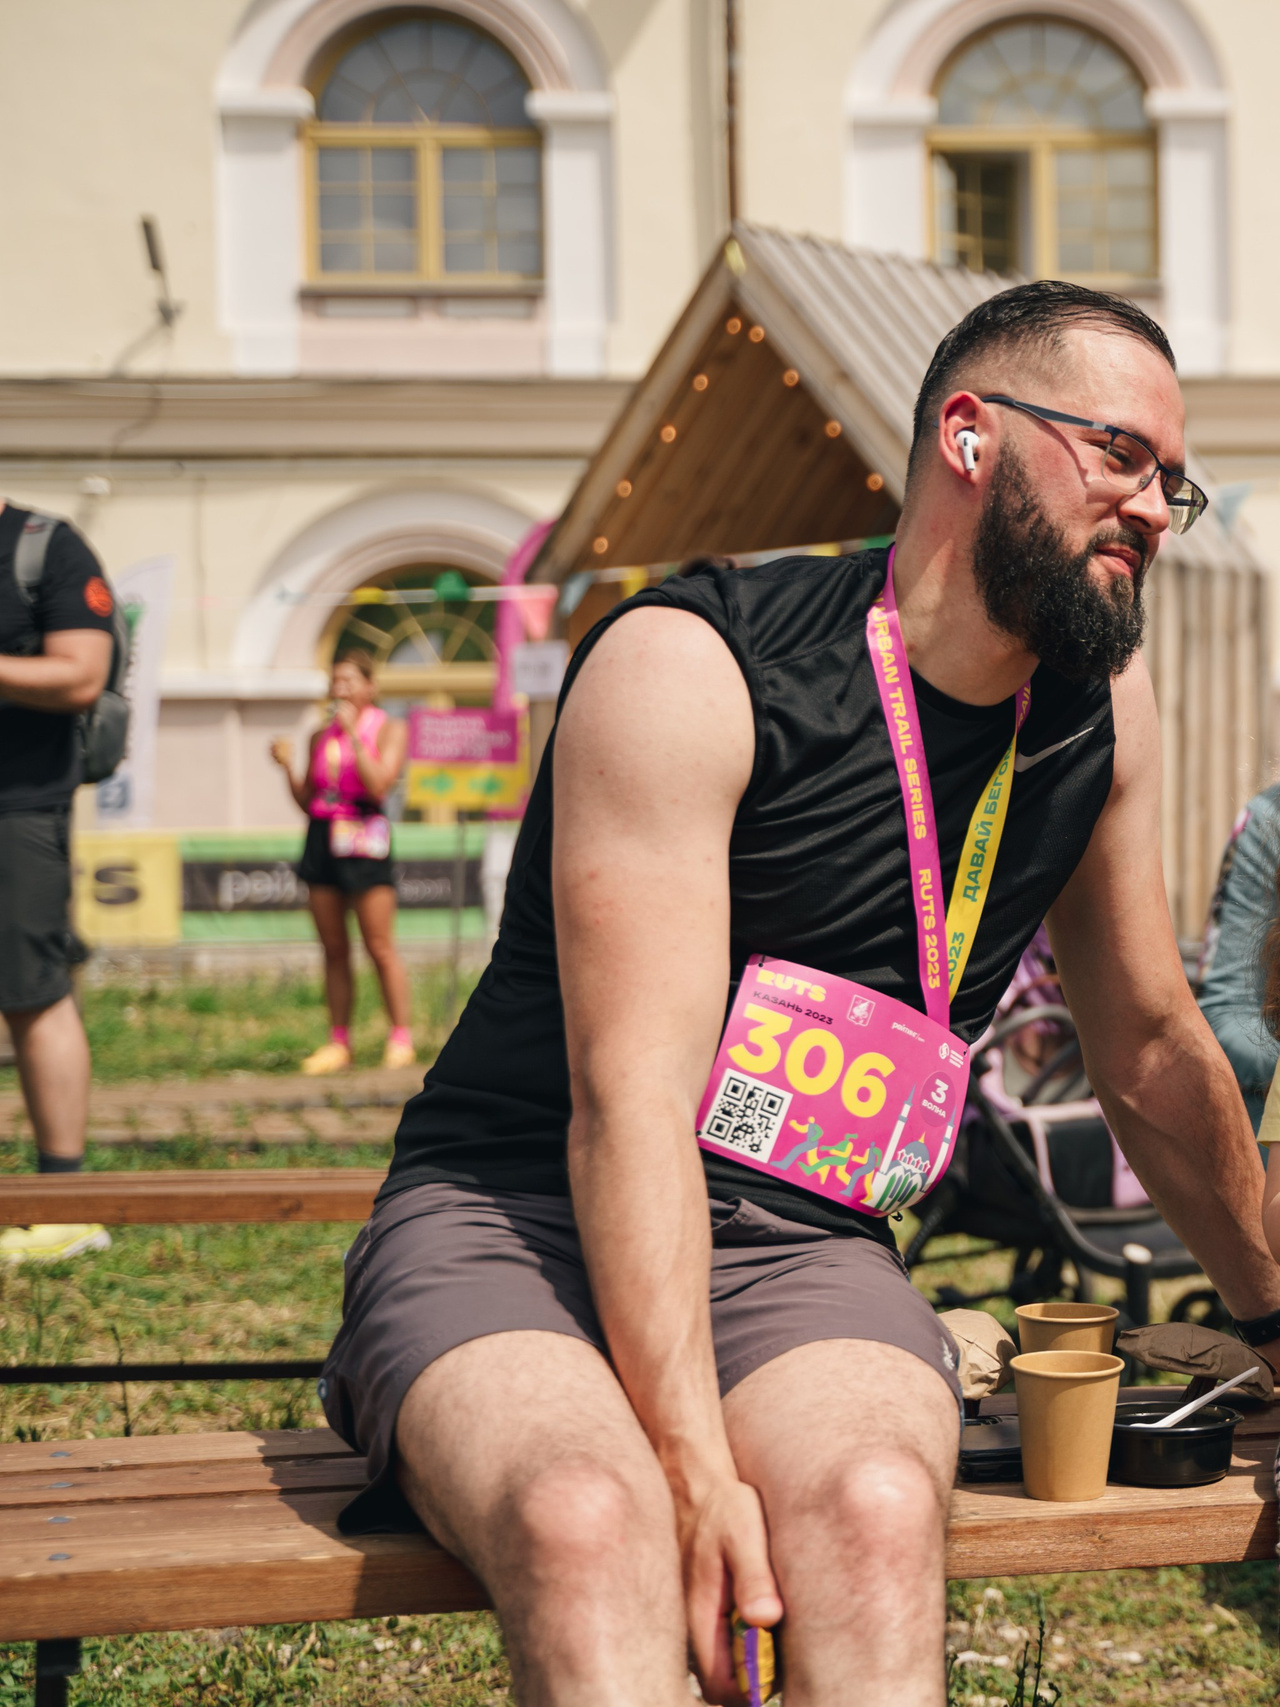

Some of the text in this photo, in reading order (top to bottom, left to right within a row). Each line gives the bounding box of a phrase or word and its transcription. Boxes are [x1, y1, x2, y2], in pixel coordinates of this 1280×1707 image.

[872, 607, 900, 684] URBAN
[888, 687, 913, 755] TRAIL
[904, 757, 927, 840] SERIES
[962, 820, 993, 902] ДАВАЙ
[918, 868, 941, 989] RUTS 2023
[756, 969, 826, 1002] RUTS
[949, 931, 965, 986] 023
[753, 990, 834, 1025] КАЗАНЬ 2023
[727, 1002, 896, 1118] 306
[922, 1099, 947, 1118] ВОЛНА
[931, 1078, 949, 1104] 3
